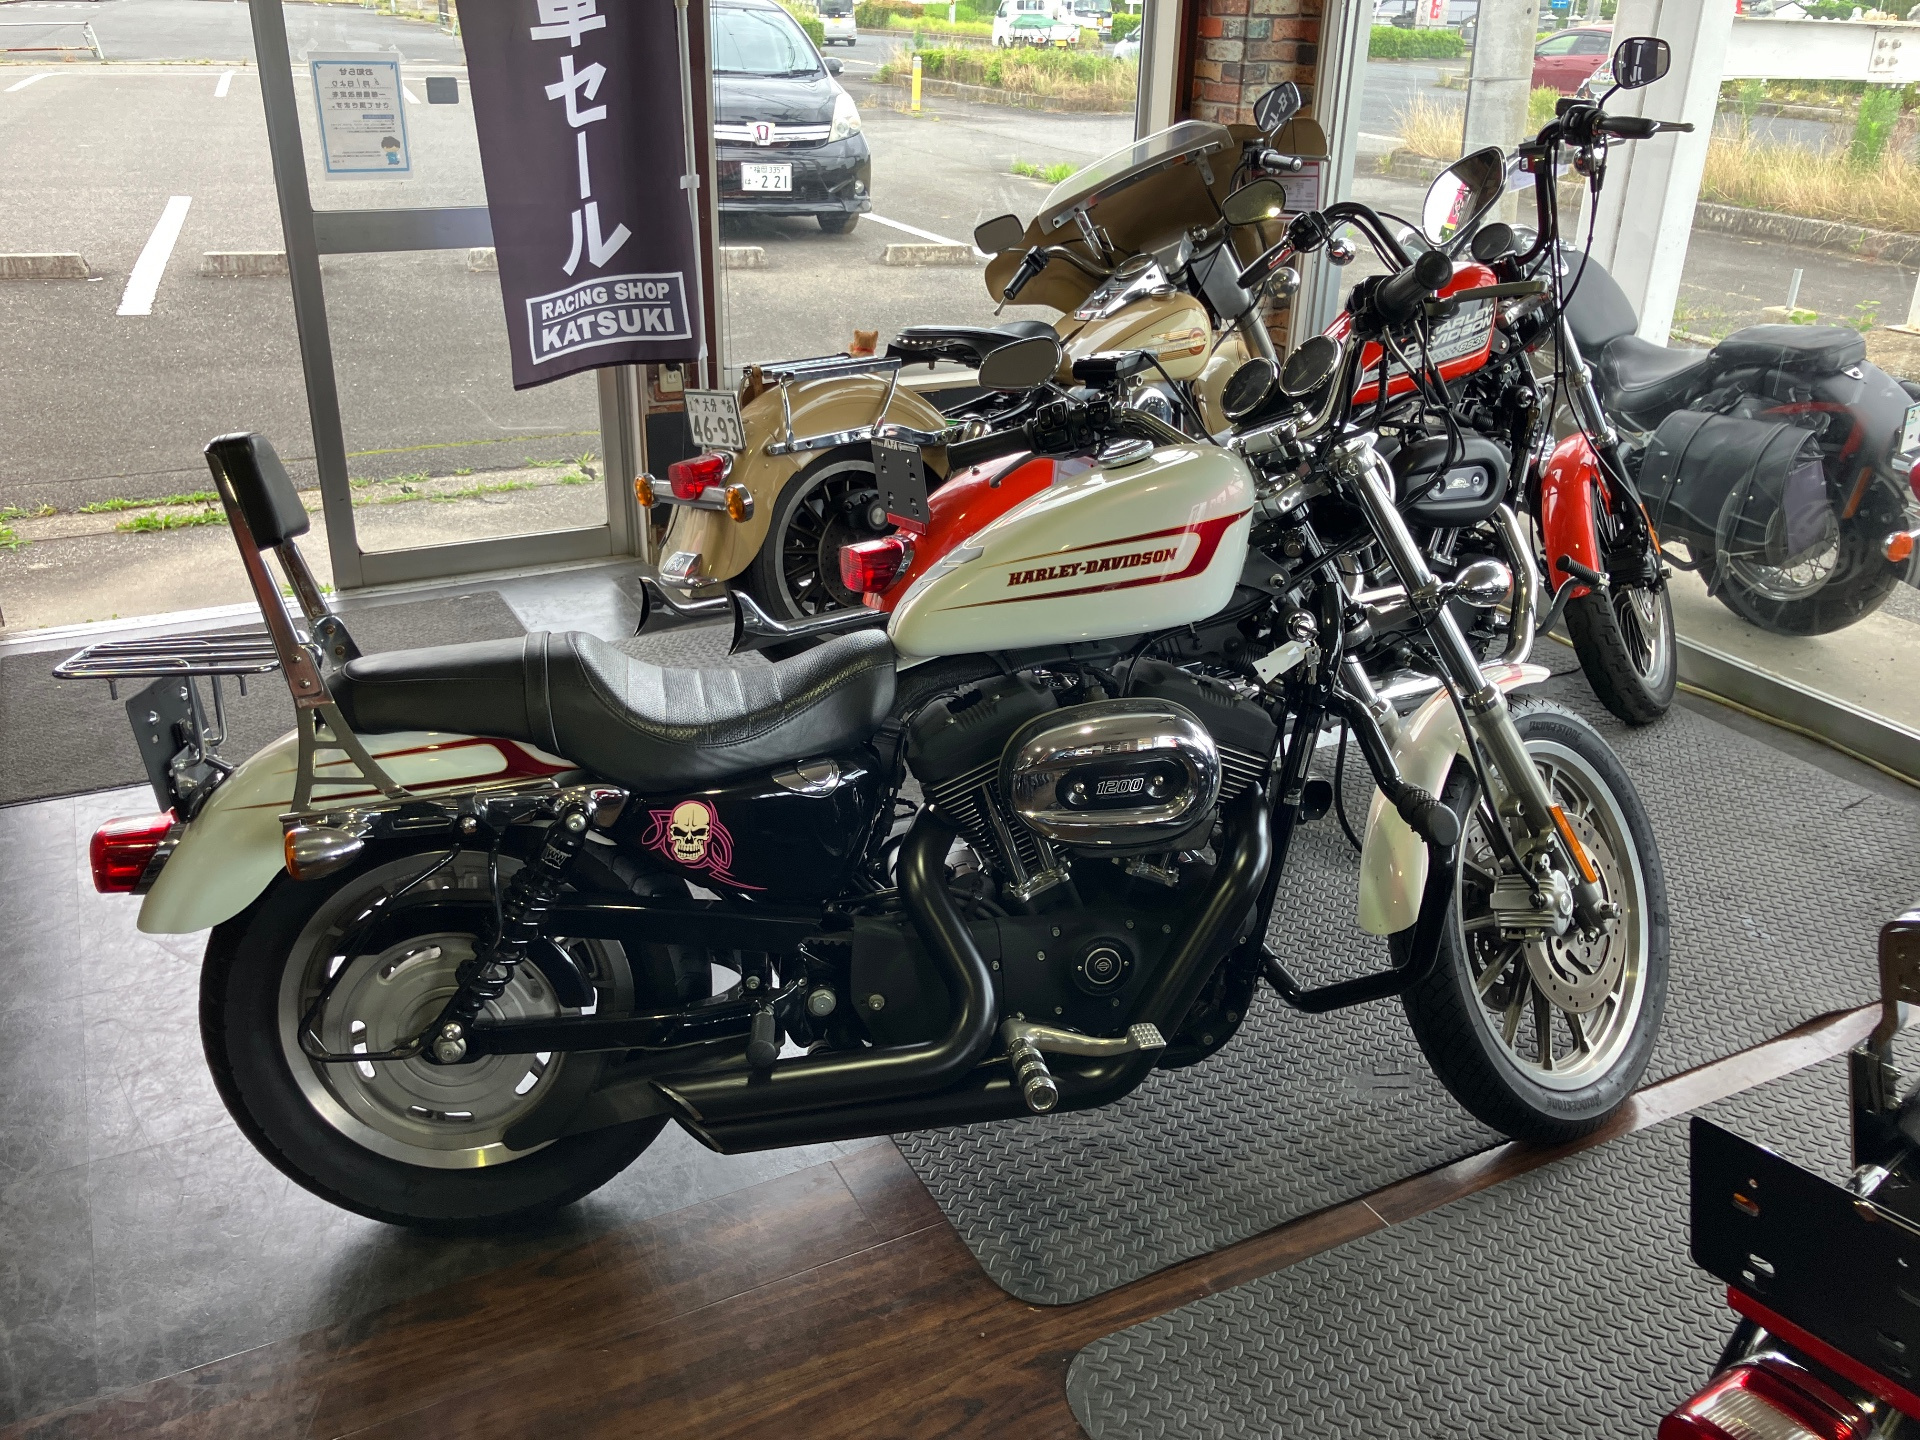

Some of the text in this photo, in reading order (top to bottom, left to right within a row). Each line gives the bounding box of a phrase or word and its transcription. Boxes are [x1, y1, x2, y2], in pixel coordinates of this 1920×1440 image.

[542, 282, 670, 320] RACING SHOP
[1435, 304, 1494, 332] ARLEY-
[542, 308, 674, 352] KATSUKI
[1404, 314, 1492, 355] DVIDSON
[702, 397, 717, 412] 大分
[694, 415, 740, 445] 46-93
[1007, 547, 1178, 587] HARLEY-DAVIDSON
[1096, 777, 1145, 795] 1200
